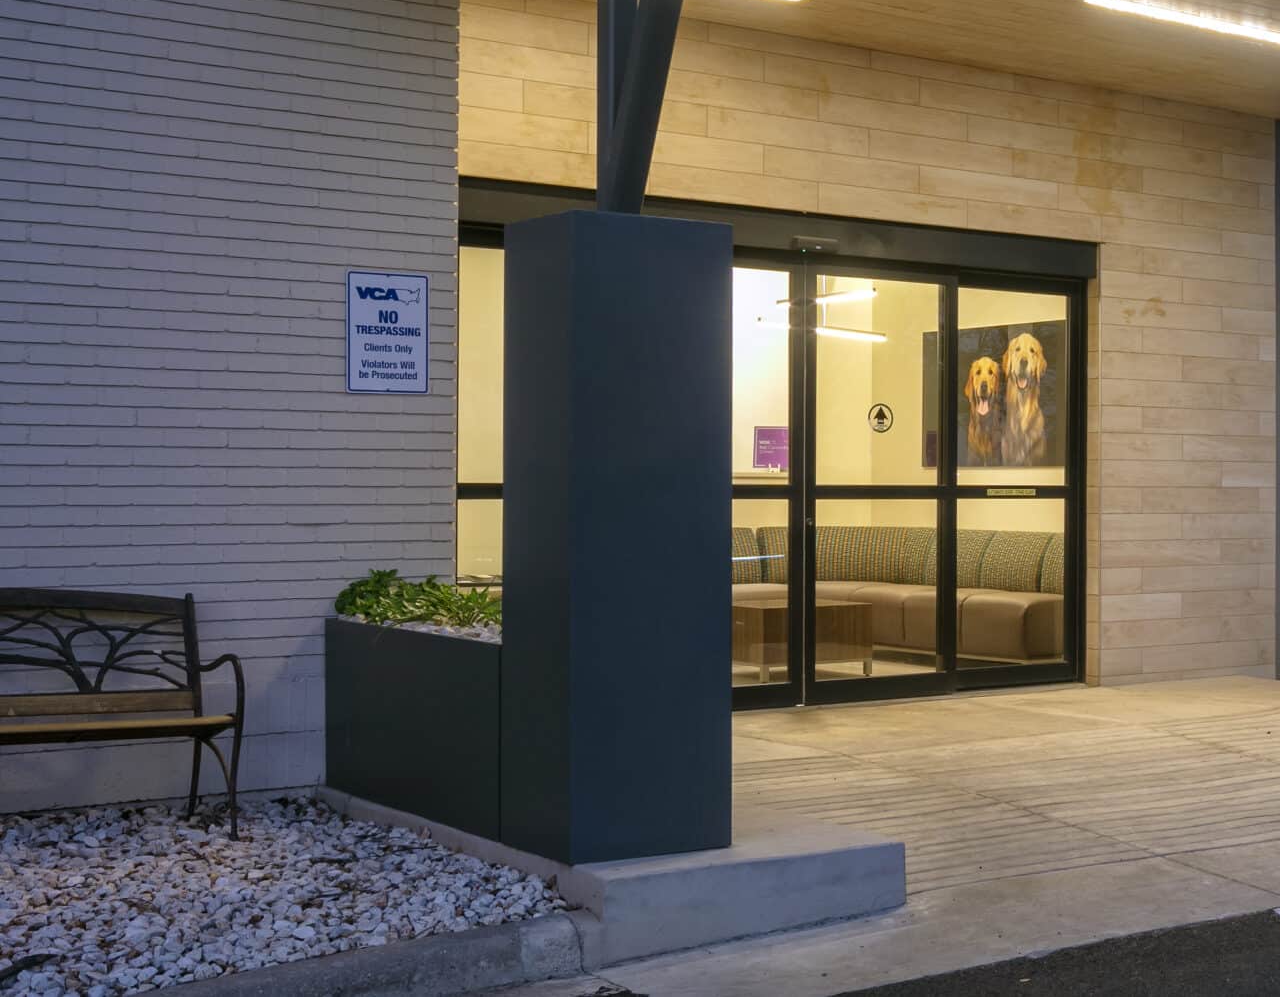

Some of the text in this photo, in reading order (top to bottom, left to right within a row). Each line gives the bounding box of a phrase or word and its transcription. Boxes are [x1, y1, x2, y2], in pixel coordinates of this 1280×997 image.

[356, 286, 399, 301] VCA
[378, 310, 398, 324] NO
[355, 324, 421, 337] TRESPASSING
[364, 343, 413, 354] Clients Only
[361, 359, 415, 370] Violators Will
[359, 370, 417, 380] be Prosecuted
